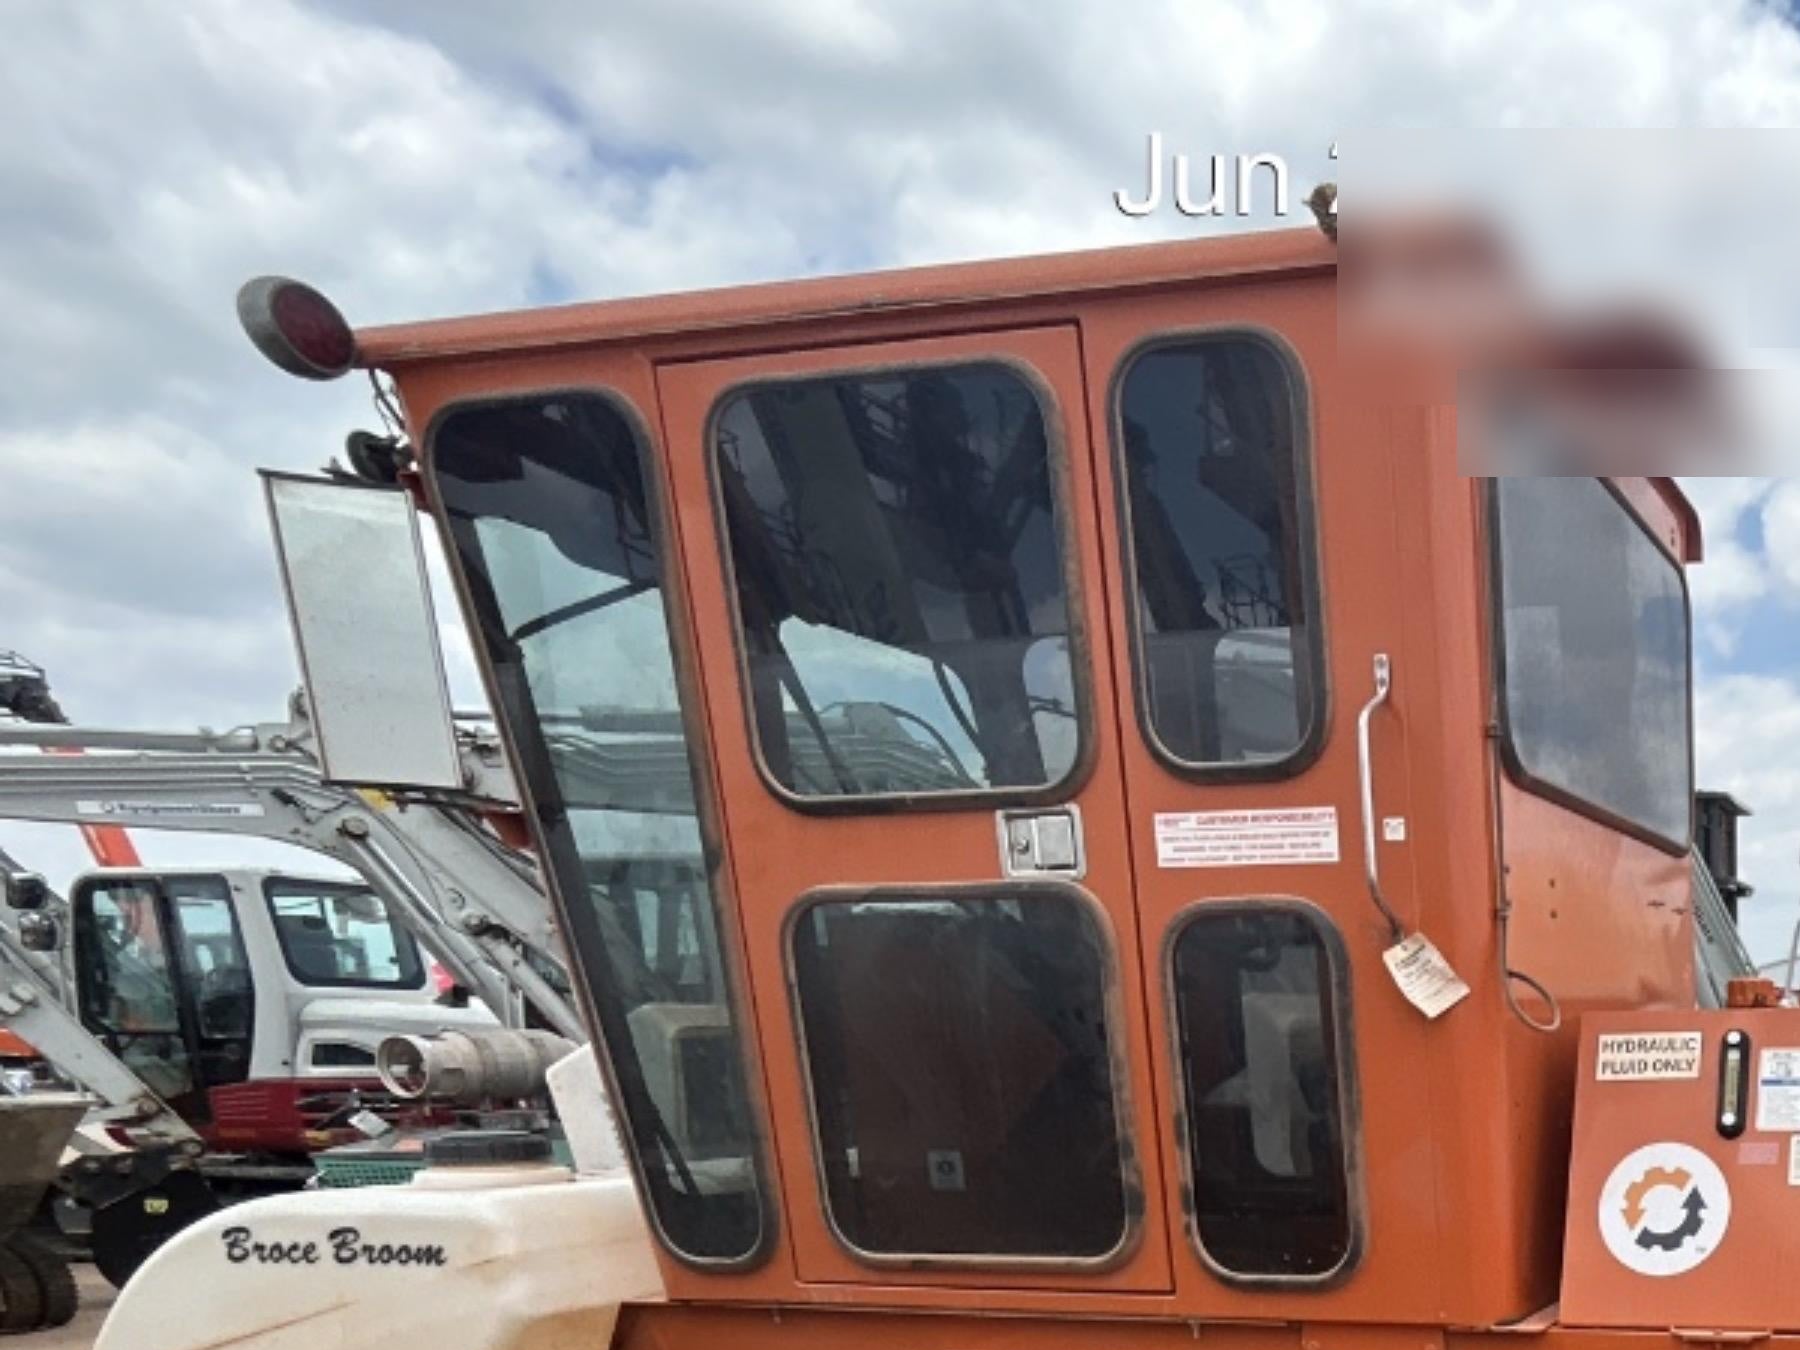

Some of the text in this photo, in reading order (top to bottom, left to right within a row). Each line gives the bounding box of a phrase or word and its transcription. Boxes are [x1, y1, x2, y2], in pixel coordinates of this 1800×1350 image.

[1601, 1037, 1697, 1054] HYDRAULIC
[1601, 1059, 1695, 1075] FLUID ONLY
[221, 1226, 447, 1266] Broce Broom
